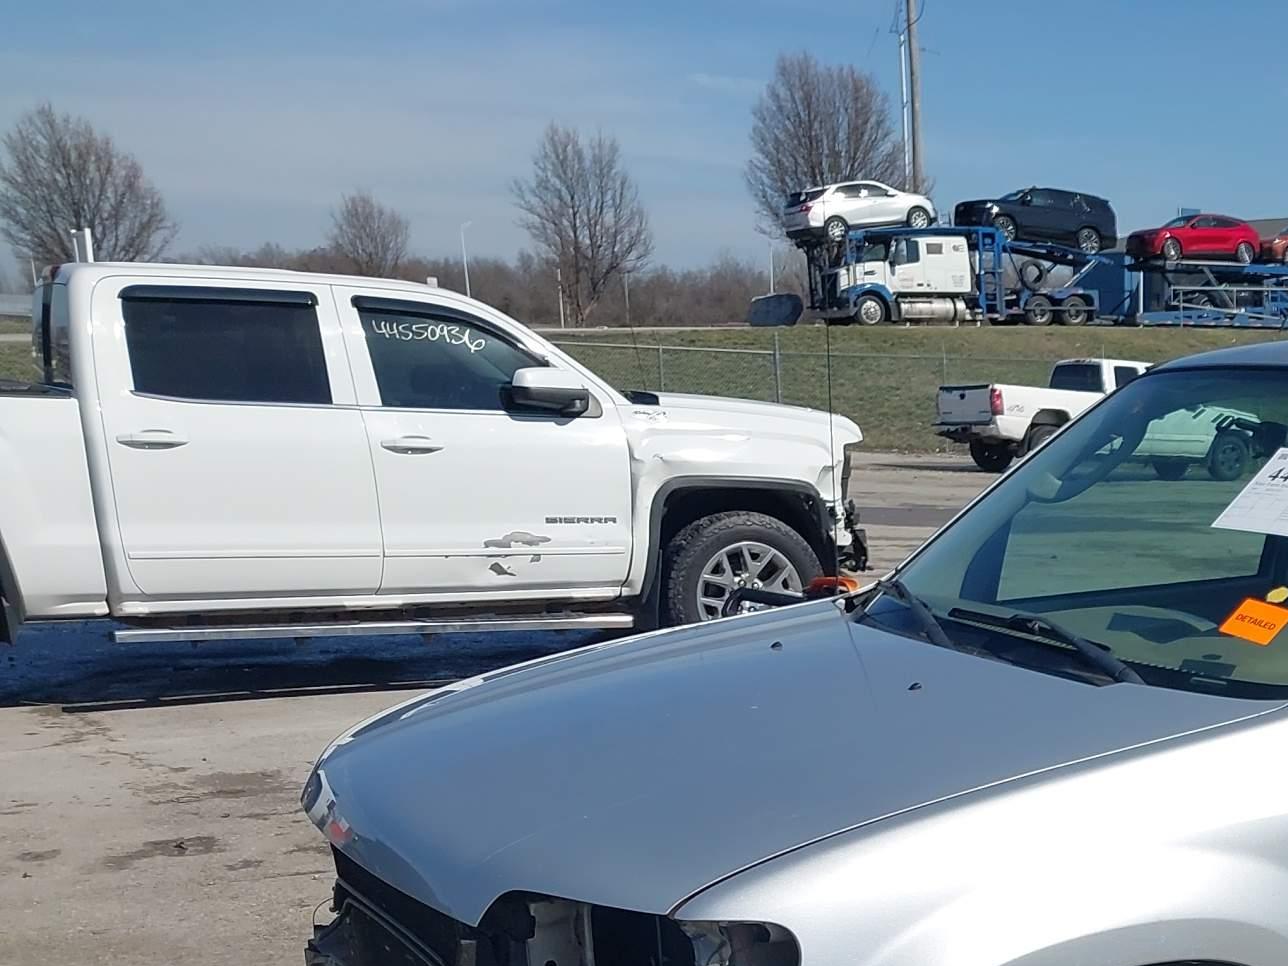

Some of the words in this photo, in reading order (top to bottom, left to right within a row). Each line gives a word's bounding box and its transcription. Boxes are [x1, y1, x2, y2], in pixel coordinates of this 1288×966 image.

[371, 319, 486, 353] 44550936
[545, 516, 617, 524] SIERRA
[1235, 613, 1277, 631] DETAILED
